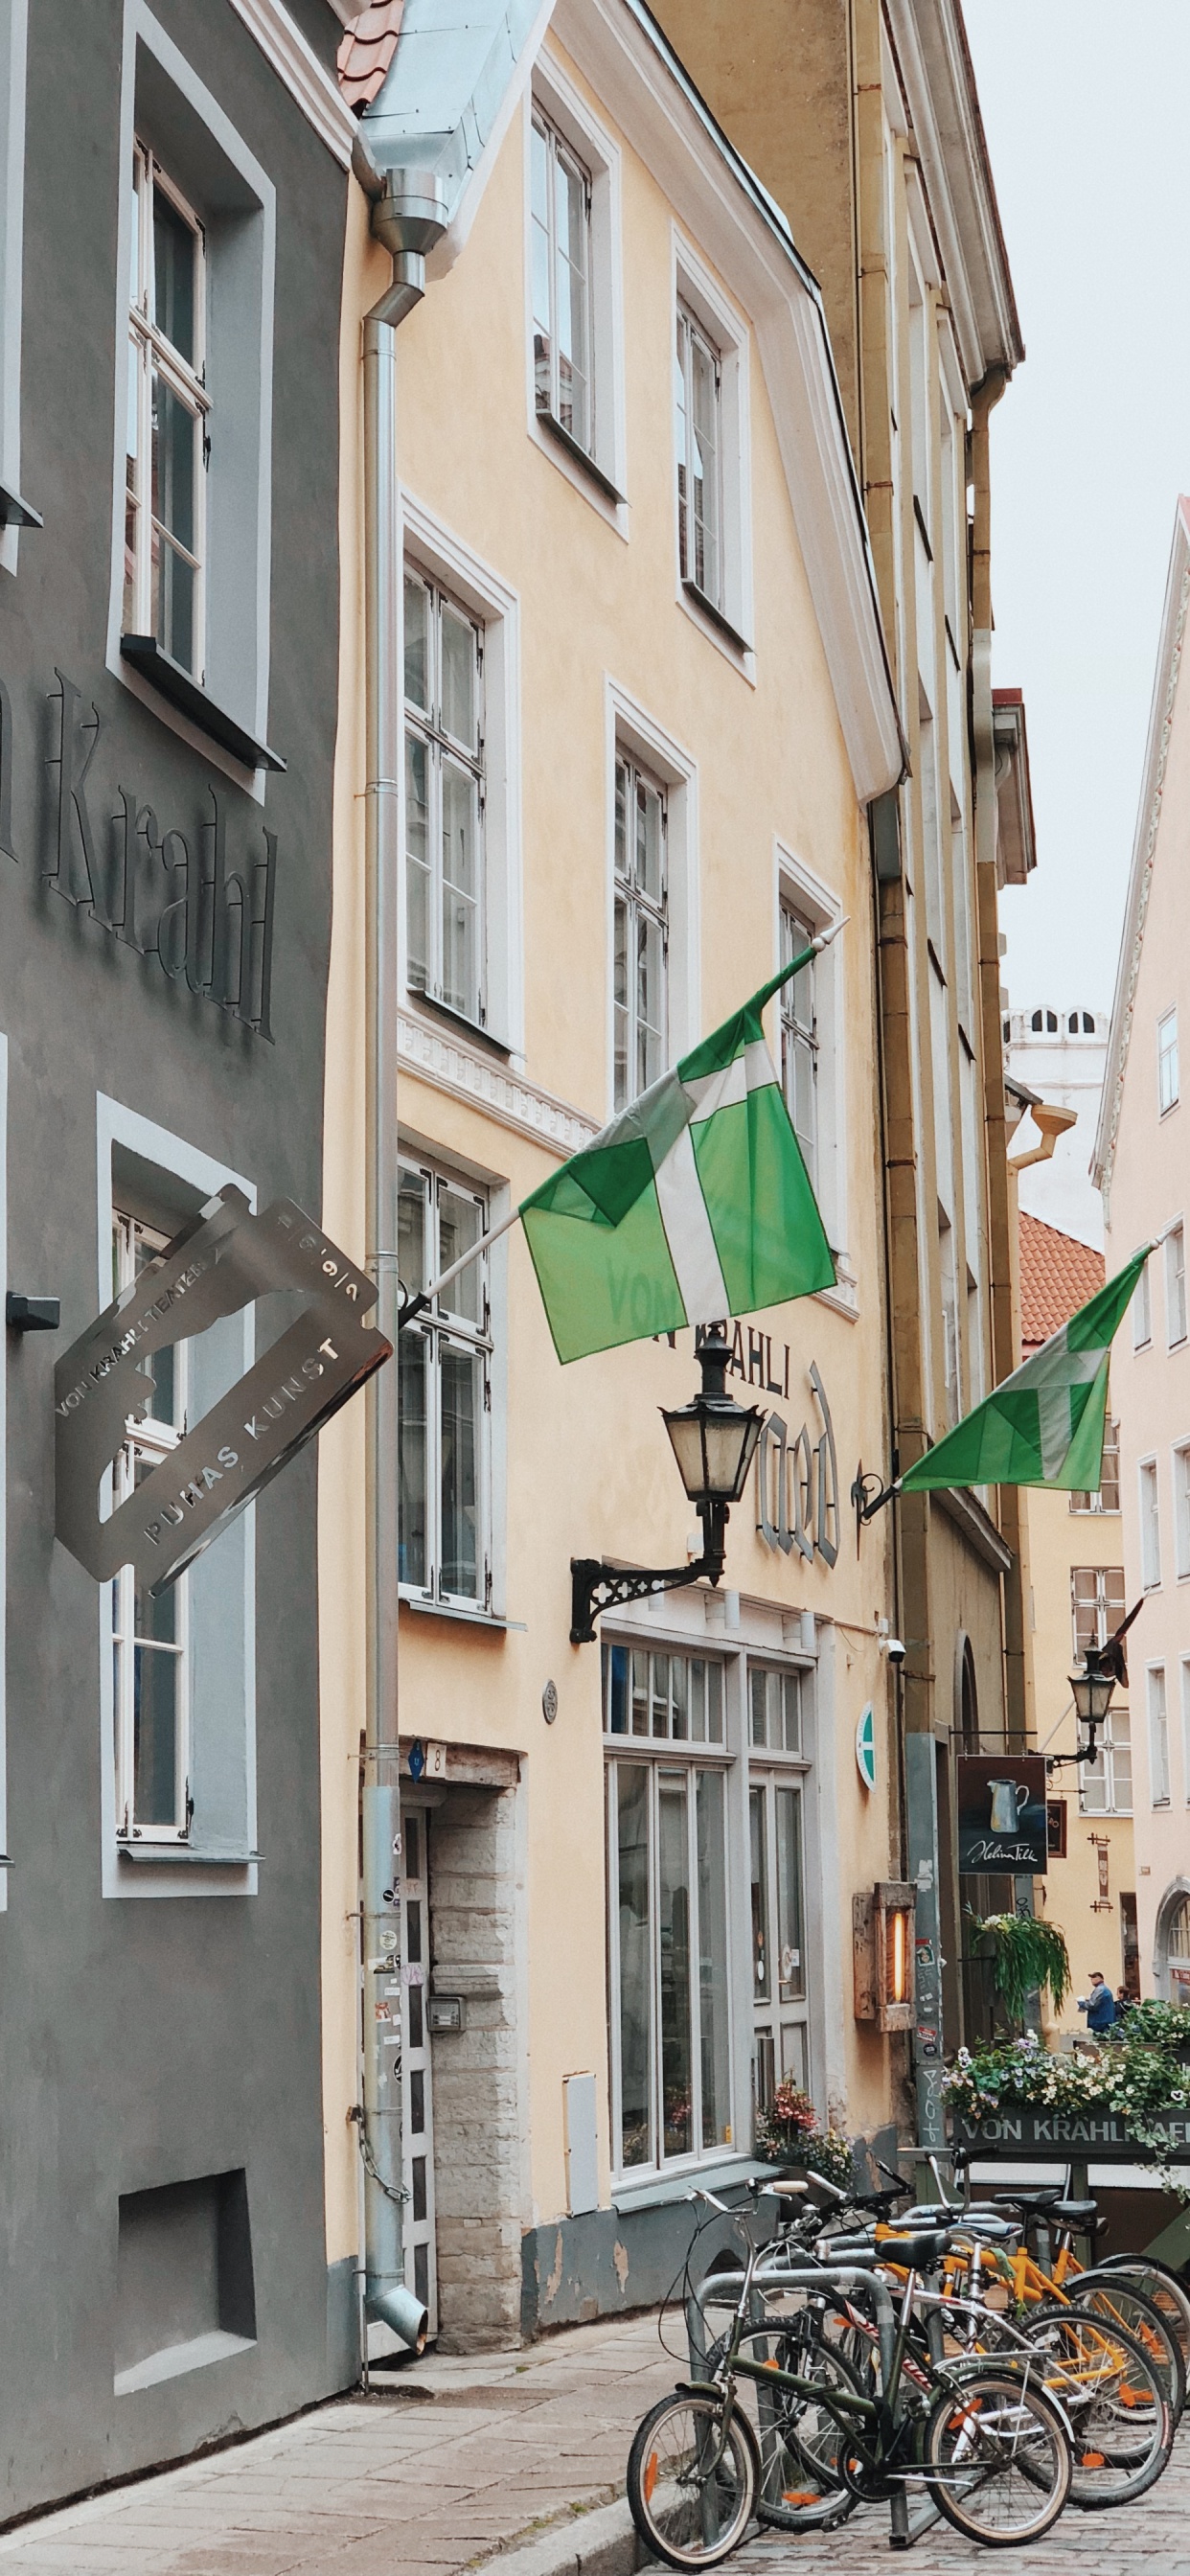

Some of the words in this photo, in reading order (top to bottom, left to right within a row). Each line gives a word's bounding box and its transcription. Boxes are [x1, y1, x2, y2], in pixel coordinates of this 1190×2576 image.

[48, 666, 278, 1046] Krahl
[55, 1380, 93, 1417] VON
[144, 1446, 240, 1546] PUHAS
[243, 1337, 339, 1440] KUNST
[434, 1749, 441, 1772] 8
[1006, 1843, 1039, 1862] Tilk
[962, 2119, 1021, 2140] VON
